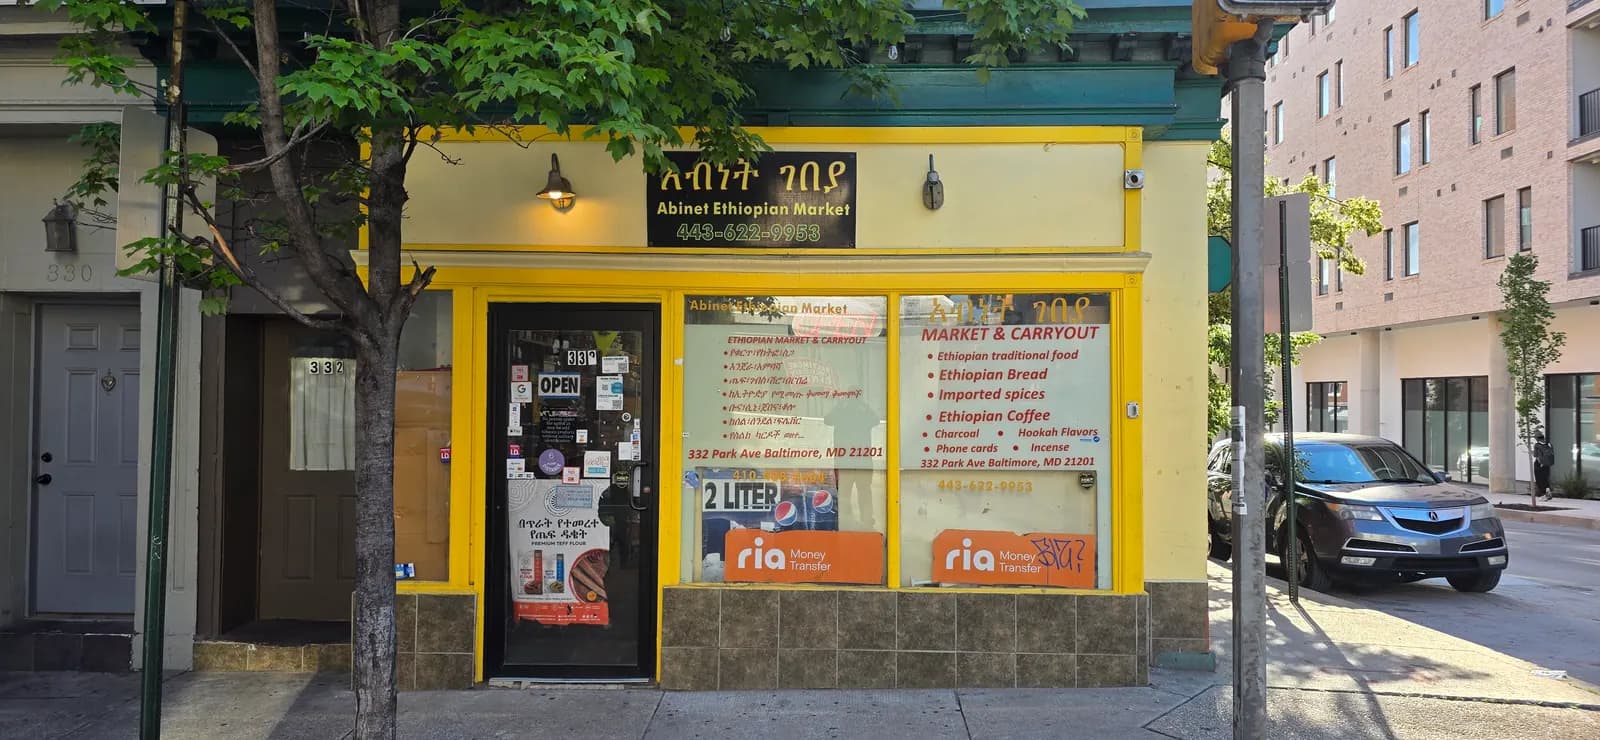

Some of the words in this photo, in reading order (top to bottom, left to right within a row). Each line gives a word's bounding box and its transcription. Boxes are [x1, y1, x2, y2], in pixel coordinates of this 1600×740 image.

[779, 160, 846, 193] ገበያ
[657, 201, 709, 215] Abinet
[713, 202, 789, 218] Ethiopian
[793, 202, 850, 216] Market
[677, 224, 820, 242] 443-622-9953
[47, 264, 93, 282] 330
[689, 299, 734, 312] Abinet
[736, 300, 797, 316] Ethiopian
[801, 302, 848, 315] Market
[1033, 296, 1090, 323] ገበያ
[727, 336, 774, 344] ETHIOPIAN
[775, 336, 810, 344] MARKET
[813, 336, 819, 344] &
[821, 336, 867, 344] CARRYOUT
[921, 327, 990, 341] MARKET
[993, 327, 1005, 341] &
[1010, 326, 1100, 340] CARRYOUT
[937, 351, 989, 363] Ethiopian
[991, 350, 1049, 360] traditional
[1051, 349, 1079, 362] food
[310, 361, 344, 375] 332
[939, 369, 1003, 383] Ethiopian
[1007, 367, 1048, 380] Bread
[540, 377, 579, 394] OPEN
[938, 388, 1002, 403] Imported
[1005, 388, 1046, 402] spices
[938, 410, 1003, 424] Ethiopian
[1007, 408, 1051, 424] Coffee
[934, 428, 980, 438] Charcoal
[1018, 427, 1058, 437] Hookah
[1060, 427, 1098, 437] Flavors
[687, 448, 709, 459] 332
[711, 448, 737, 459] Park
[739, 448, 761, 458] Ave
[764, 447, 822, 460] Baltimore,
[825, 447, 847, 458] MD
[848, 446, 883, 457] 21201
[935, 443, 968, 454] Phone
[970, 443, 999, 453] cards
[1030, 442, 1070, 452] Incense
[920, 459, 939, 469] 332
[941, 458, 964, 468] Park
[966, 458, 986, 467] Ave
[988, 457, 1041, 468] Baltimore,
[1043, 457, 1062, 466] MD
[1064, 456, 1095, 466] 21201
[705, 482, 718, 509] 2
[724, 482, 778, 509] LITER
[737, 536, 785, 570] ria
[790, 549, 826, 562] Money
[945, 538, 995, 572] ria
[999, 550, 1036, 564] Money
[790, 560, 831, 572] Transfer
[999, 562, 1041, 575] Transfer
